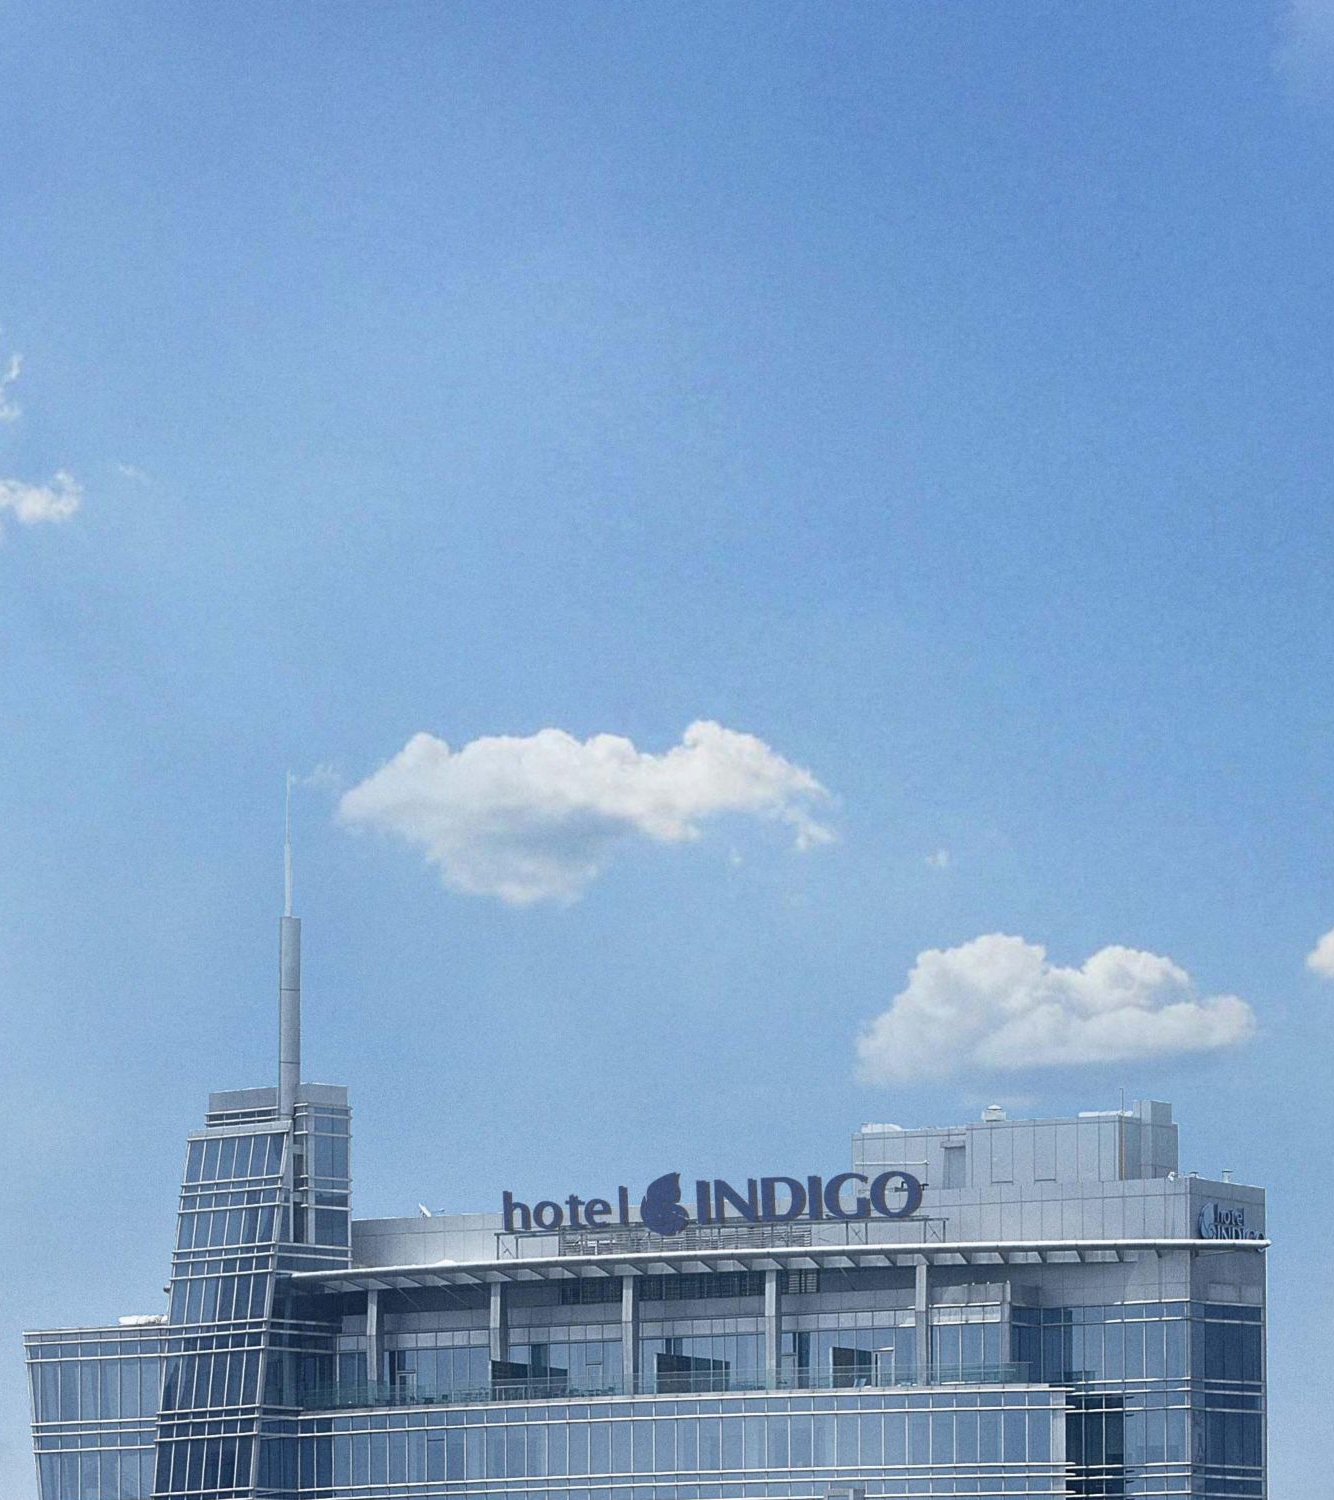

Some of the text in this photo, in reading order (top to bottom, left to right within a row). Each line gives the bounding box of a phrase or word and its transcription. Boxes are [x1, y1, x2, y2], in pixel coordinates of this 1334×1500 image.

[502, 1170, 924, 1231] hotel INDIGO
[1213, 1203, 1245, 1226] hotel
